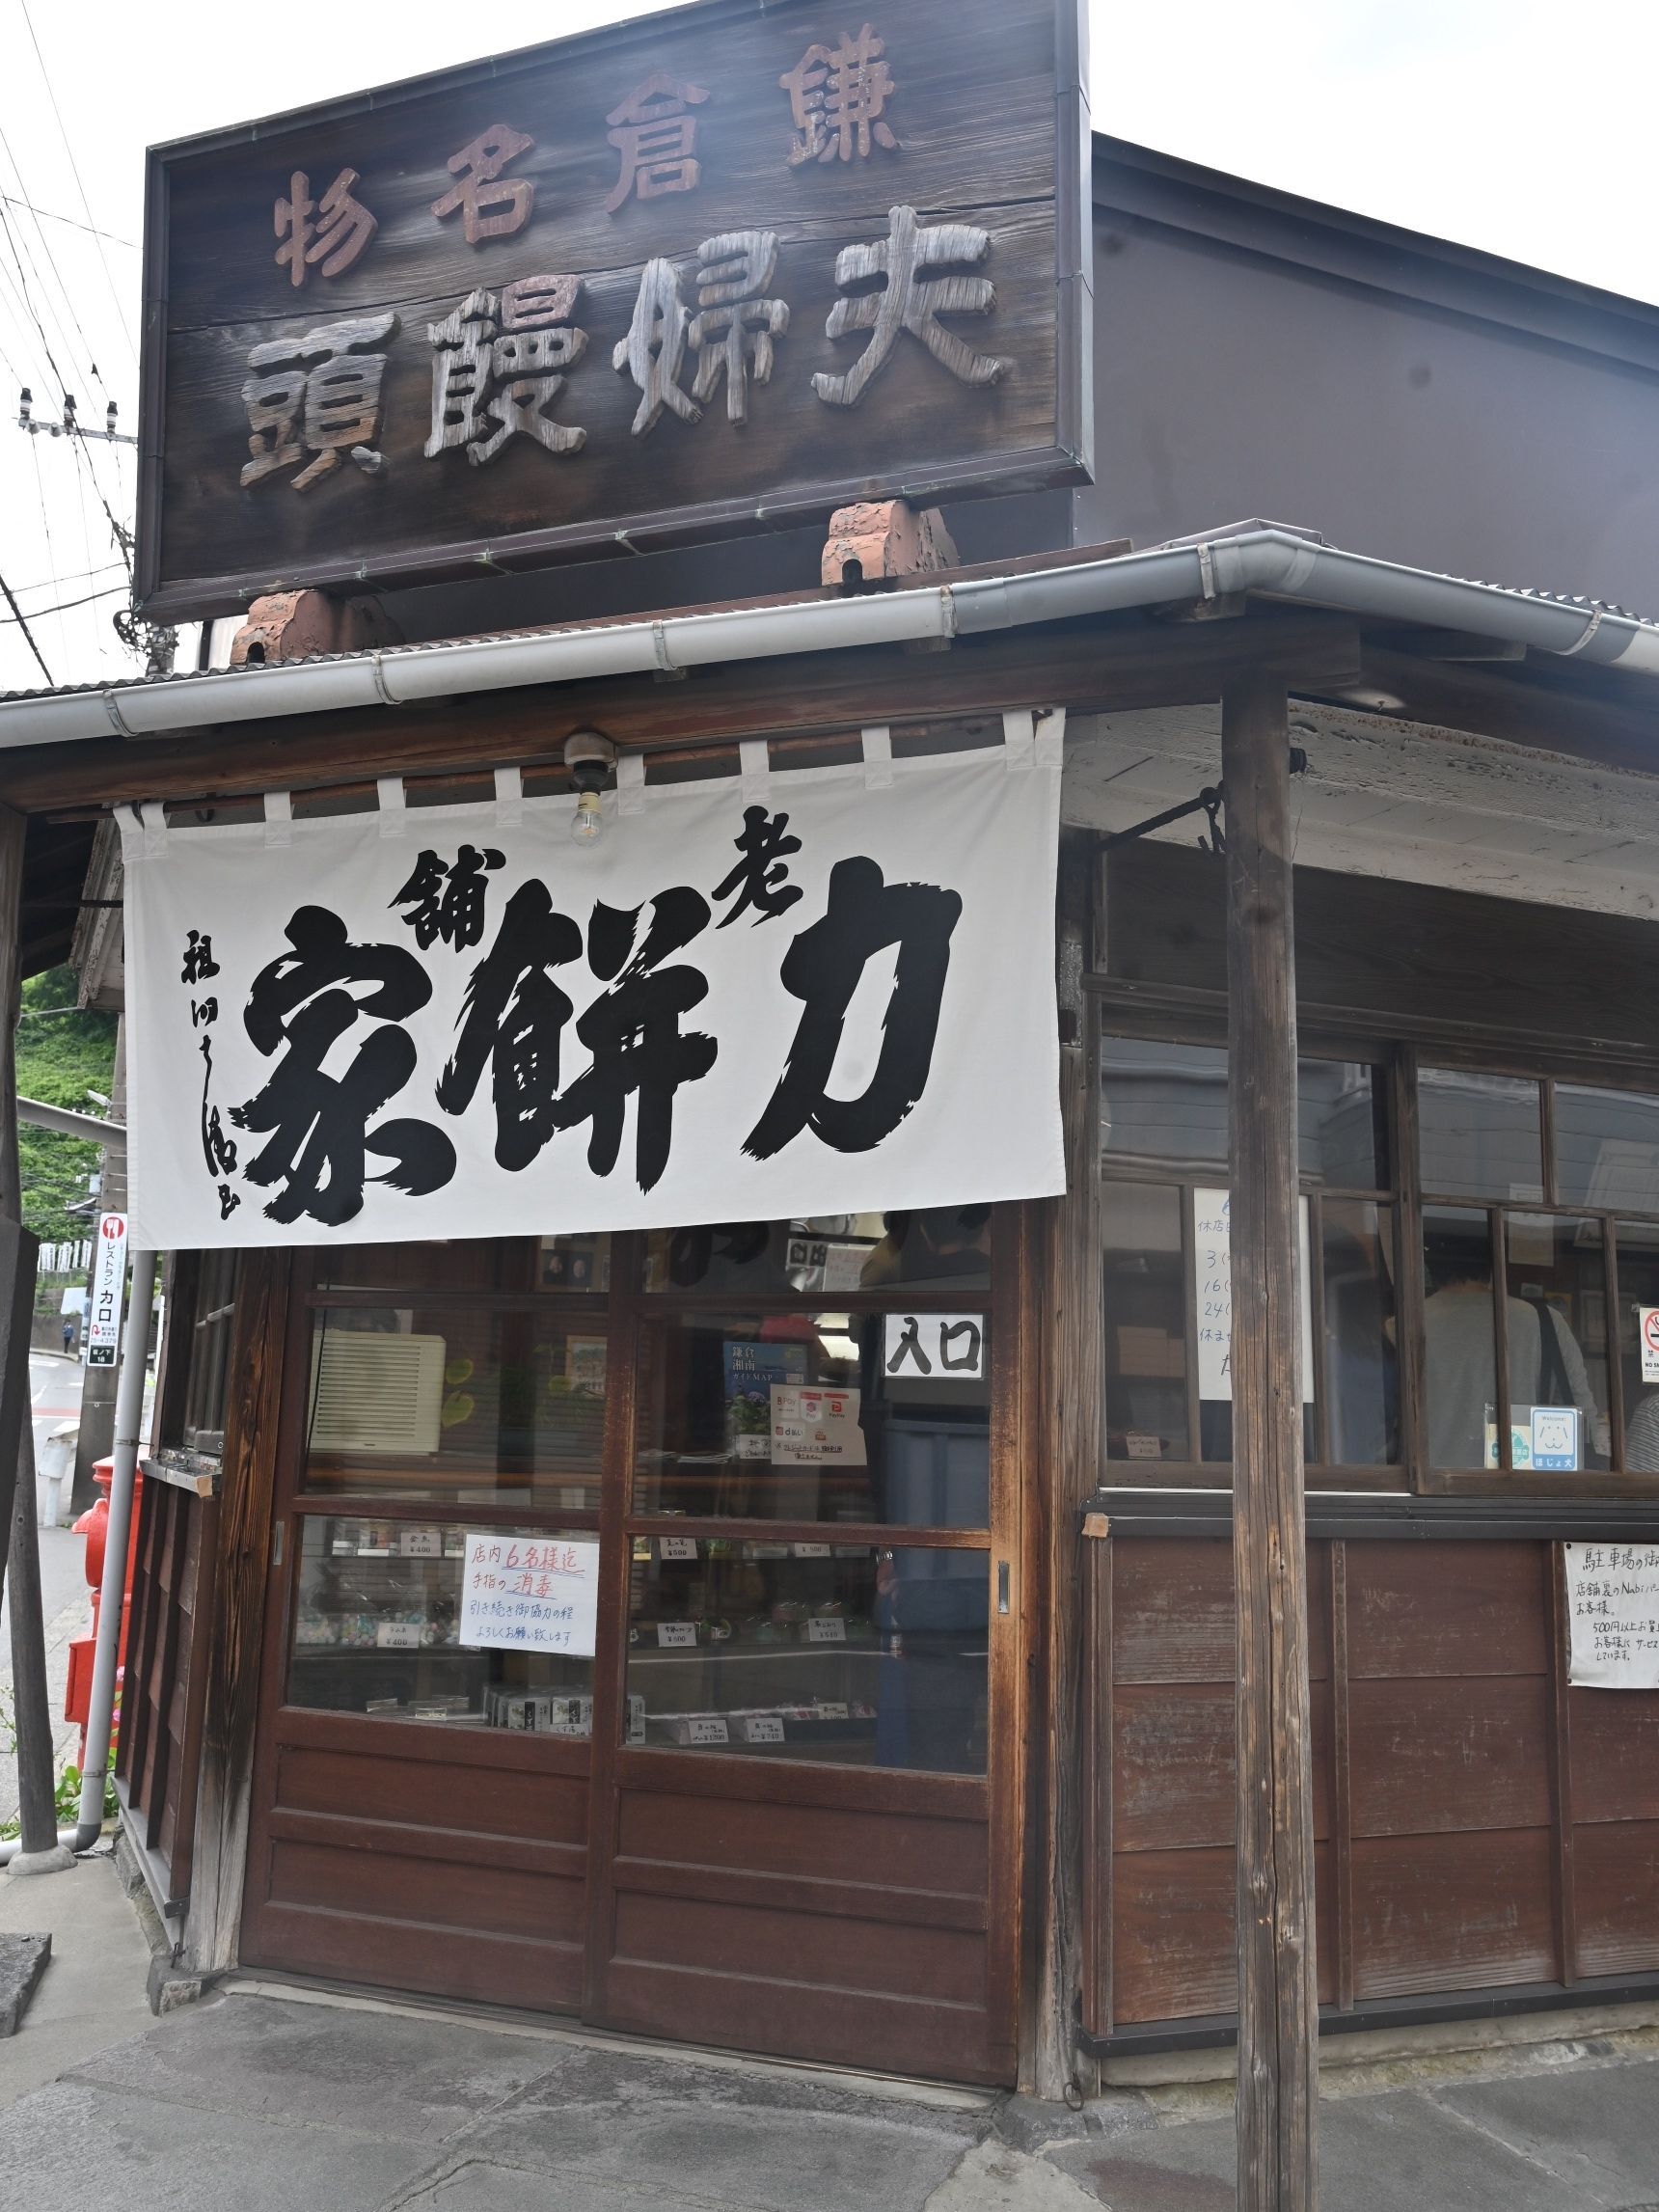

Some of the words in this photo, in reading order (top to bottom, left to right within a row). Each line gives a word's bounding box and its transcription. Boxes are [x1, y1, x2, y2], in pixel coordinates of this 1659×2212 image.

[273, 22, 904, 289] 鎌倉名物
[239, 205, 1013, 494] 夫婦饅頭
[229, 855, 964, 1227] 力餅家
[103, 1242, 116, 1286] レストラン
[732, 1346, 755, 1358] 鎌倉
[886, 1316, 982, 1376] 入口
[1536, 1458, 1572, 1468] ほじょ犬
[472, 1543, 586, 1574] 店内6名様迄
[473, 1571, 554, 1598] 手指の消毒
